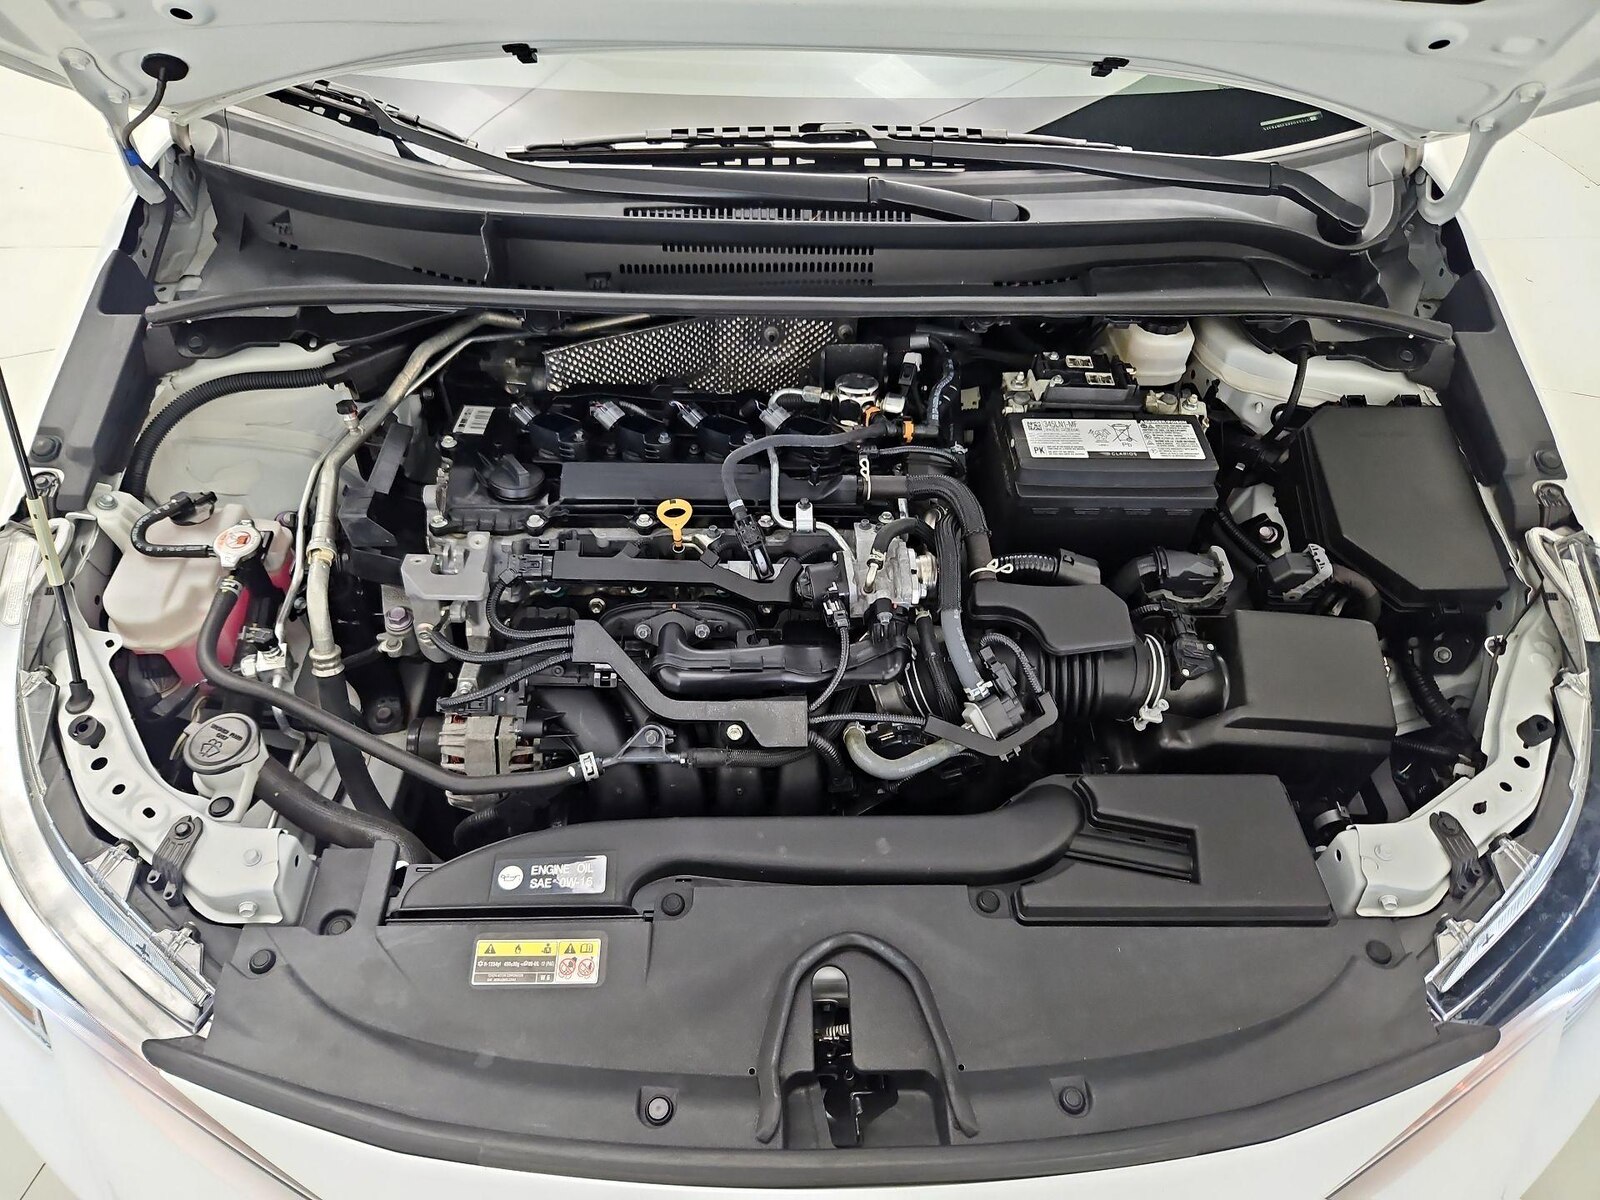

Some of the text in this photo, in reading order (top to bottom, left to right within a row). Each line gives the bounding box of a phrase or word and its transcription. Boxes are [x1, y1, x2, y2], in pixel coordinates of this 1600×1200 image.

[1033, 446, 1046, 454] PK
[531, 861, 594, 876] ENGINE OIL
[529, 875, 593, 889] SAE 0W-16
